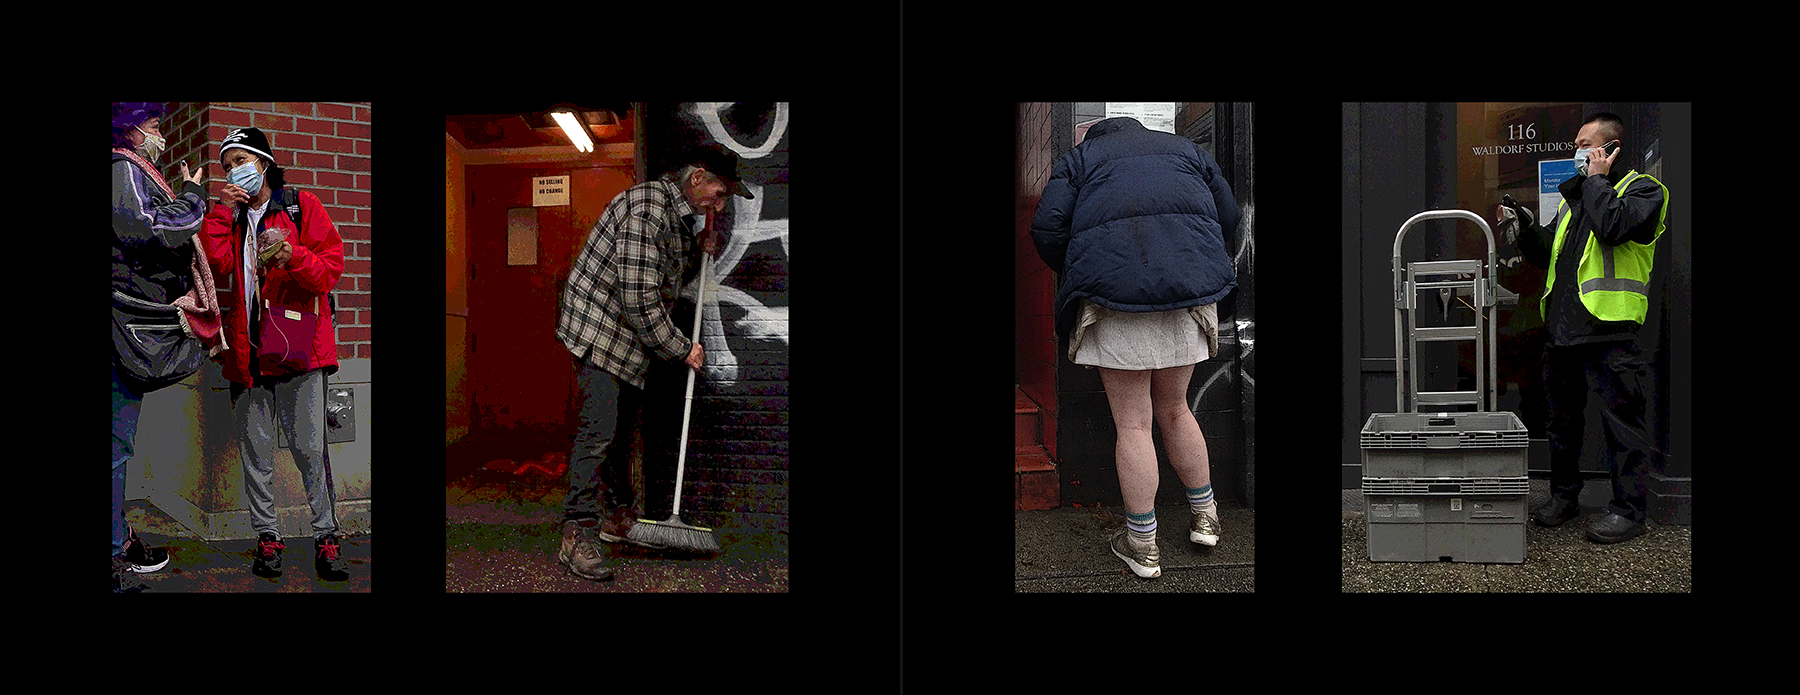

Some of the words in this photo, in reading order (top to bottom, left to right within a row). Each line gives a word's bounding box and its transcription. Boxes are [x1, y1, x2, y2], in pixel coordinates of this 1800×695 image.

[1508, 123, 1536, 141] 116
[1472, 144, 1525, 155] WALDORF
[1526, 141, 1574, 153] STUDIOS
